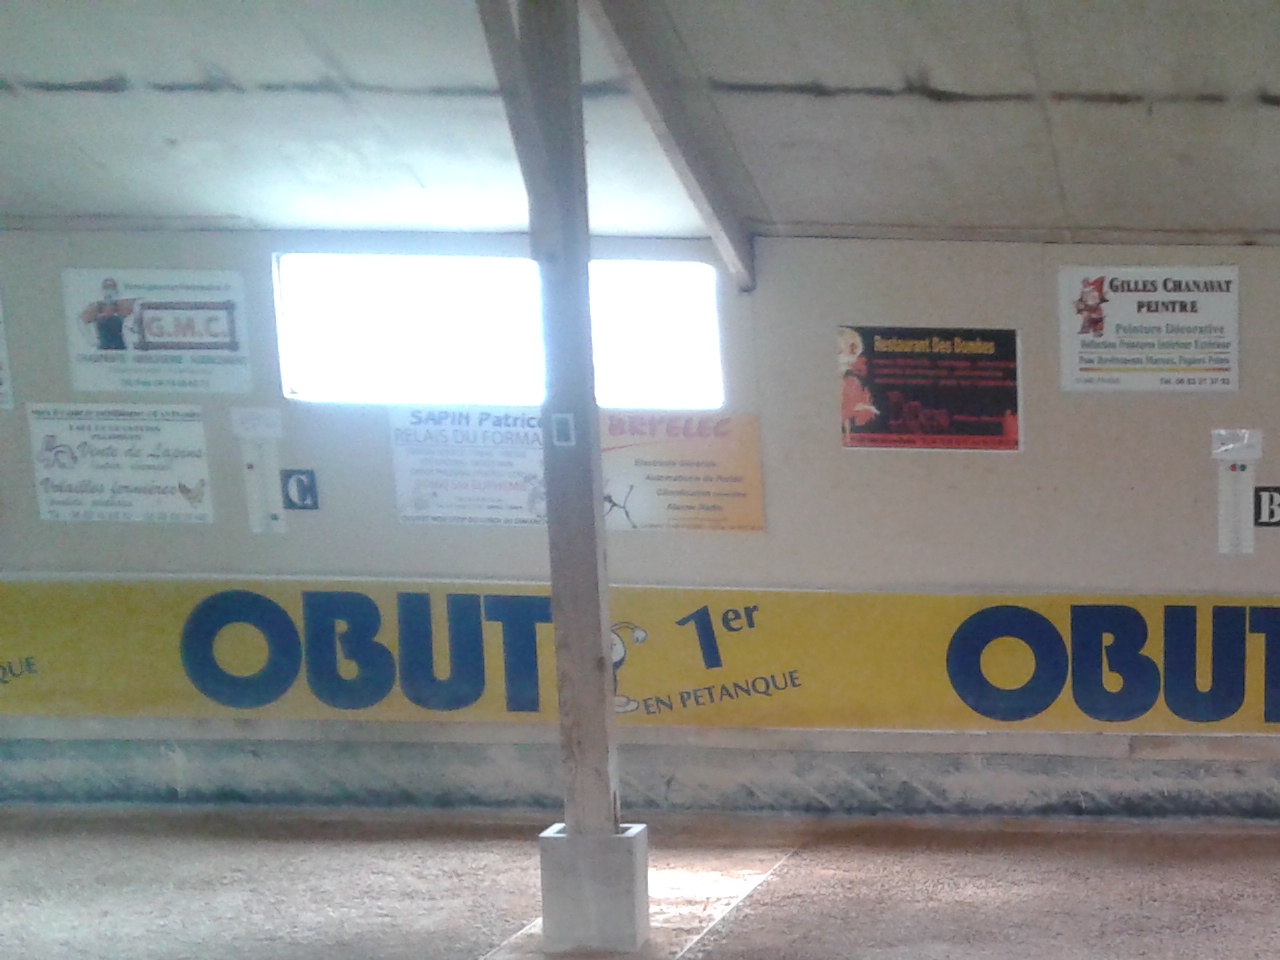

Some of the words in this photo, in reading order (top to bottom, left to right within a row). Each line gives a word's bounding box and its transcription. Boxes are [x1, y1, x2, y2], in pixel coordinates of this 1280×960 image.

[1108, 277, 1159, 294] GILLES
[1136, 300, 1199, 313] PEINTRE
[286, 473, 312, 507] C
[181, 588, 552, 713] OBUT
[675, 604, 759, 670] 1er
[643, 696, 673, 715] EN
[679, 669, 802, 709] PETANQUE
